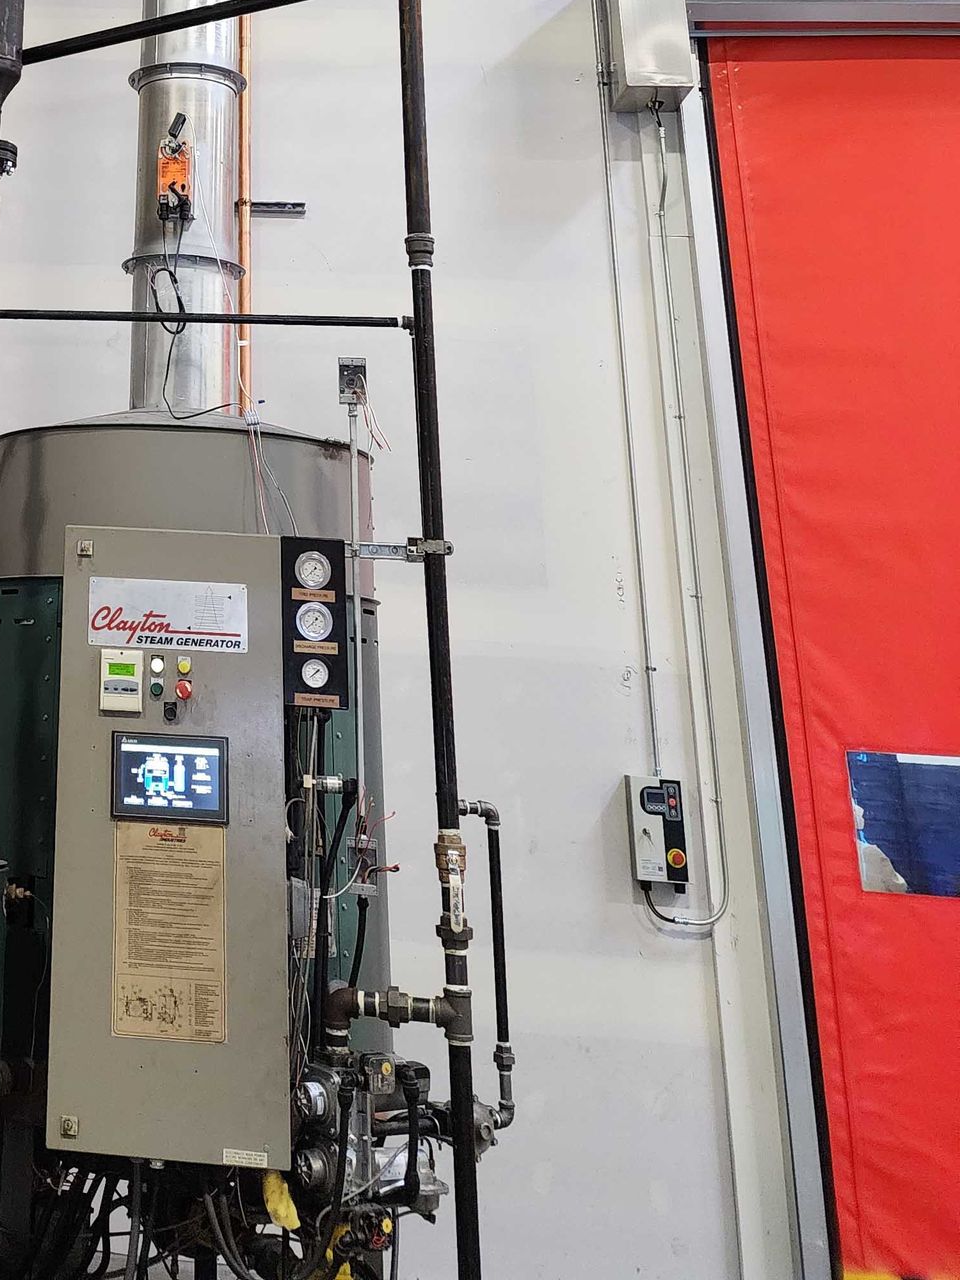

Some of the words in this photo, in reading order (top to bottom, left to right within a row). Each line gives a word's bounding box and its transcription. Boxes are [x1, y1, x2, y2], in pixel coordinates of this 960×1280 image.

[90, 605, 175, 644] Clayton
[136, 635, 173, 646] STEAM
[176, 639, 241, 649] GENERATOR
